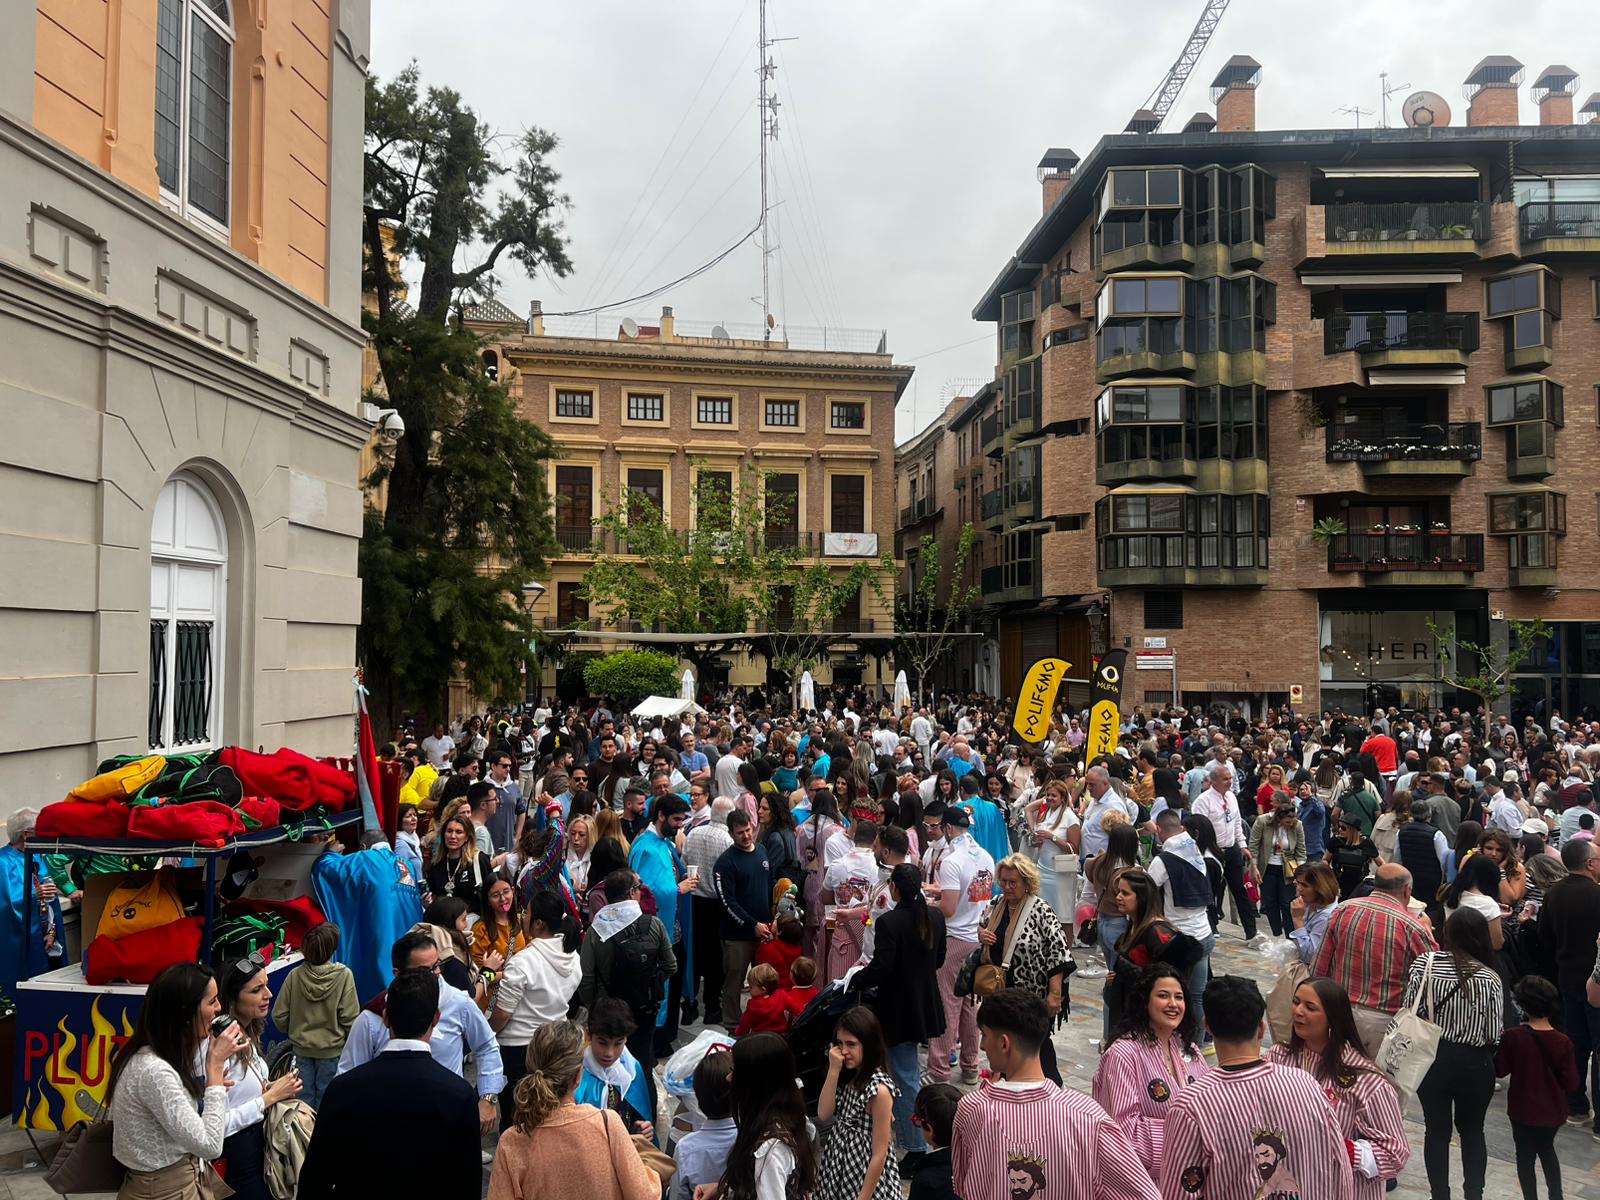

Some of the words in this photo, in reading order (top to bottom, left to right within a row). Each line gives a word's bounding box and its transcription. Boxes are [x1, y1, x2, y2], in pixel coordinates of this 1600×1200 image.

[1367, 642, 1452, 660] HERA
[1023, 661, 1056, 737] POLIFEMO
[1096, 681, 1119, 694] POLIFEM
[1097, 708, 1113, 756] FEMO
